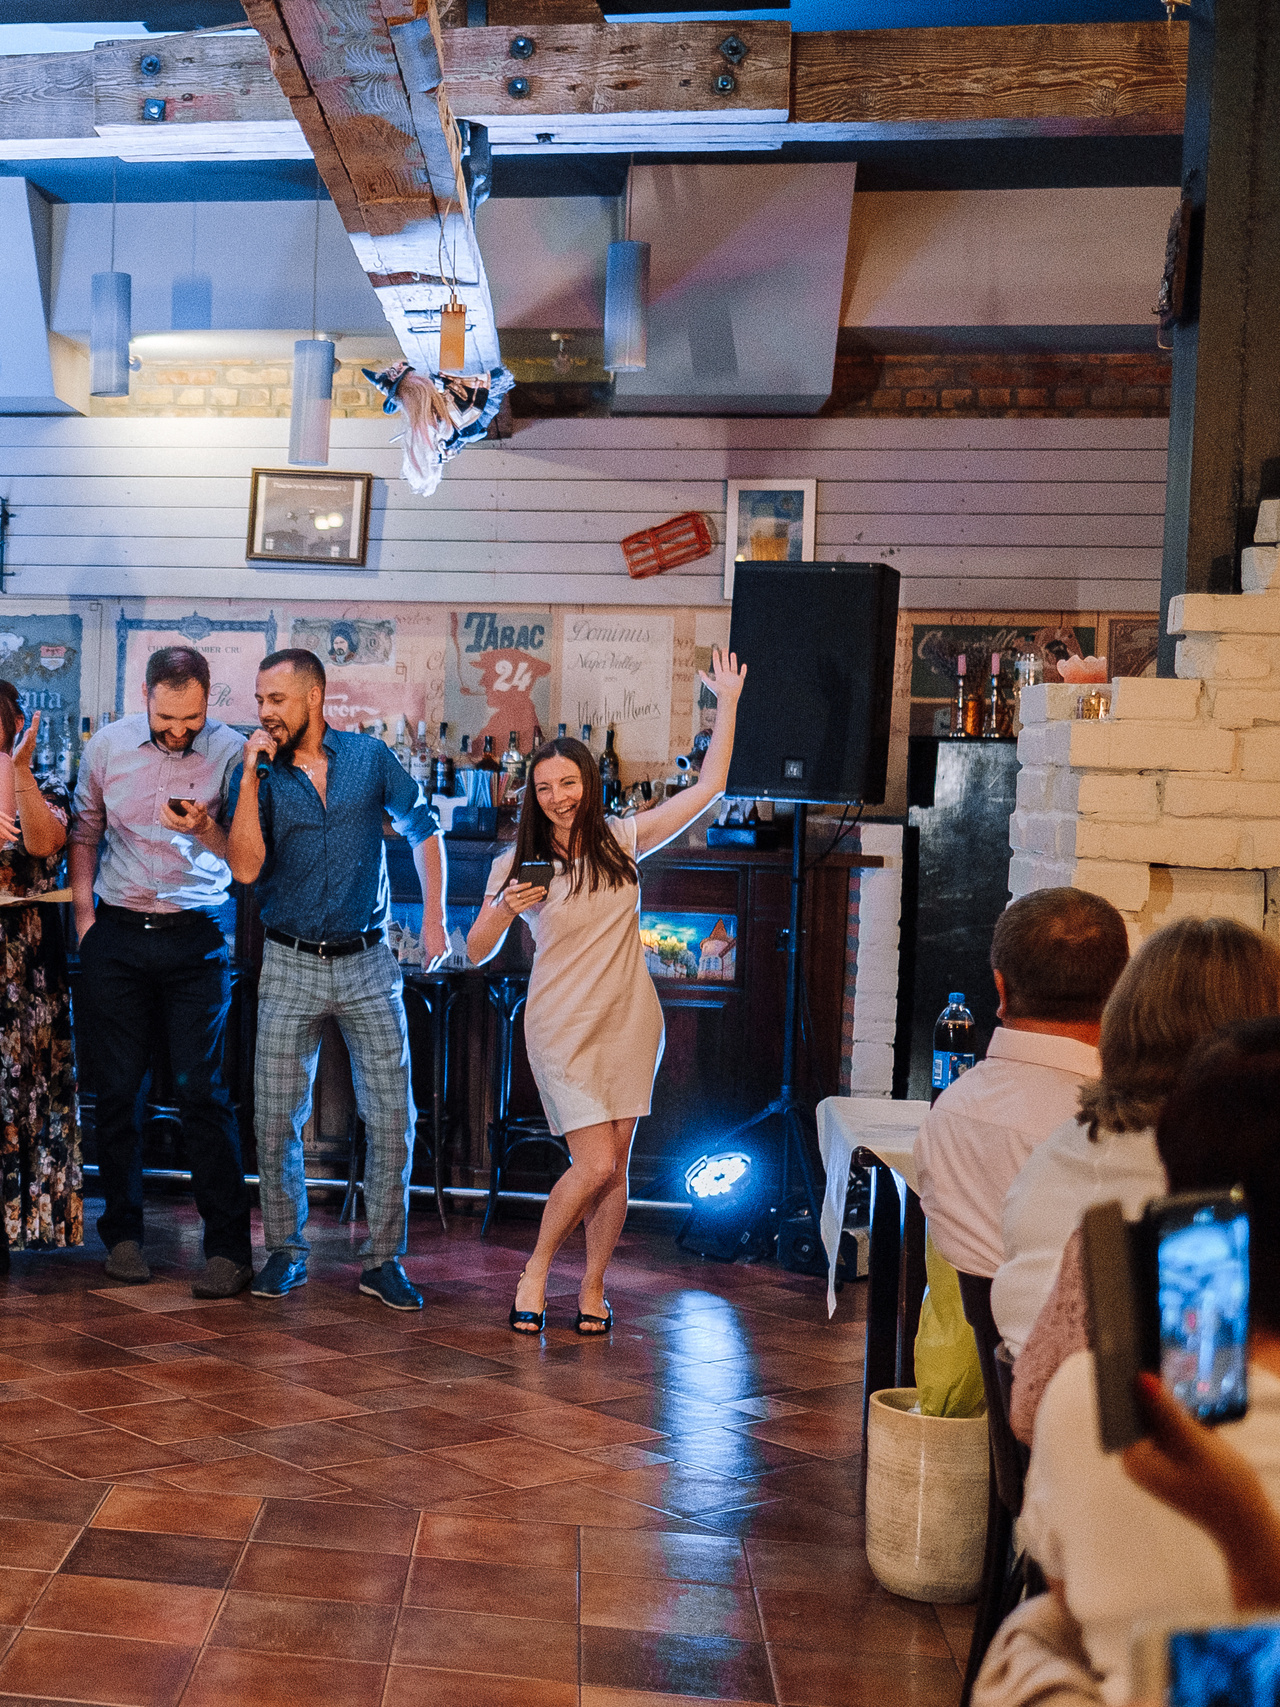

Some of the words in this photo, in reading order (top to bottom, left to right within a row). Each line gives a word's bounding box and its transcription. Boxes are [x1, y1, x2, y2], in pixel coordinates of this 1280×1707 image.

[567, 620, 650, 643] Dominus
[225, 647, 241, 655] CRU
[493, 660, 532, 692] 24
